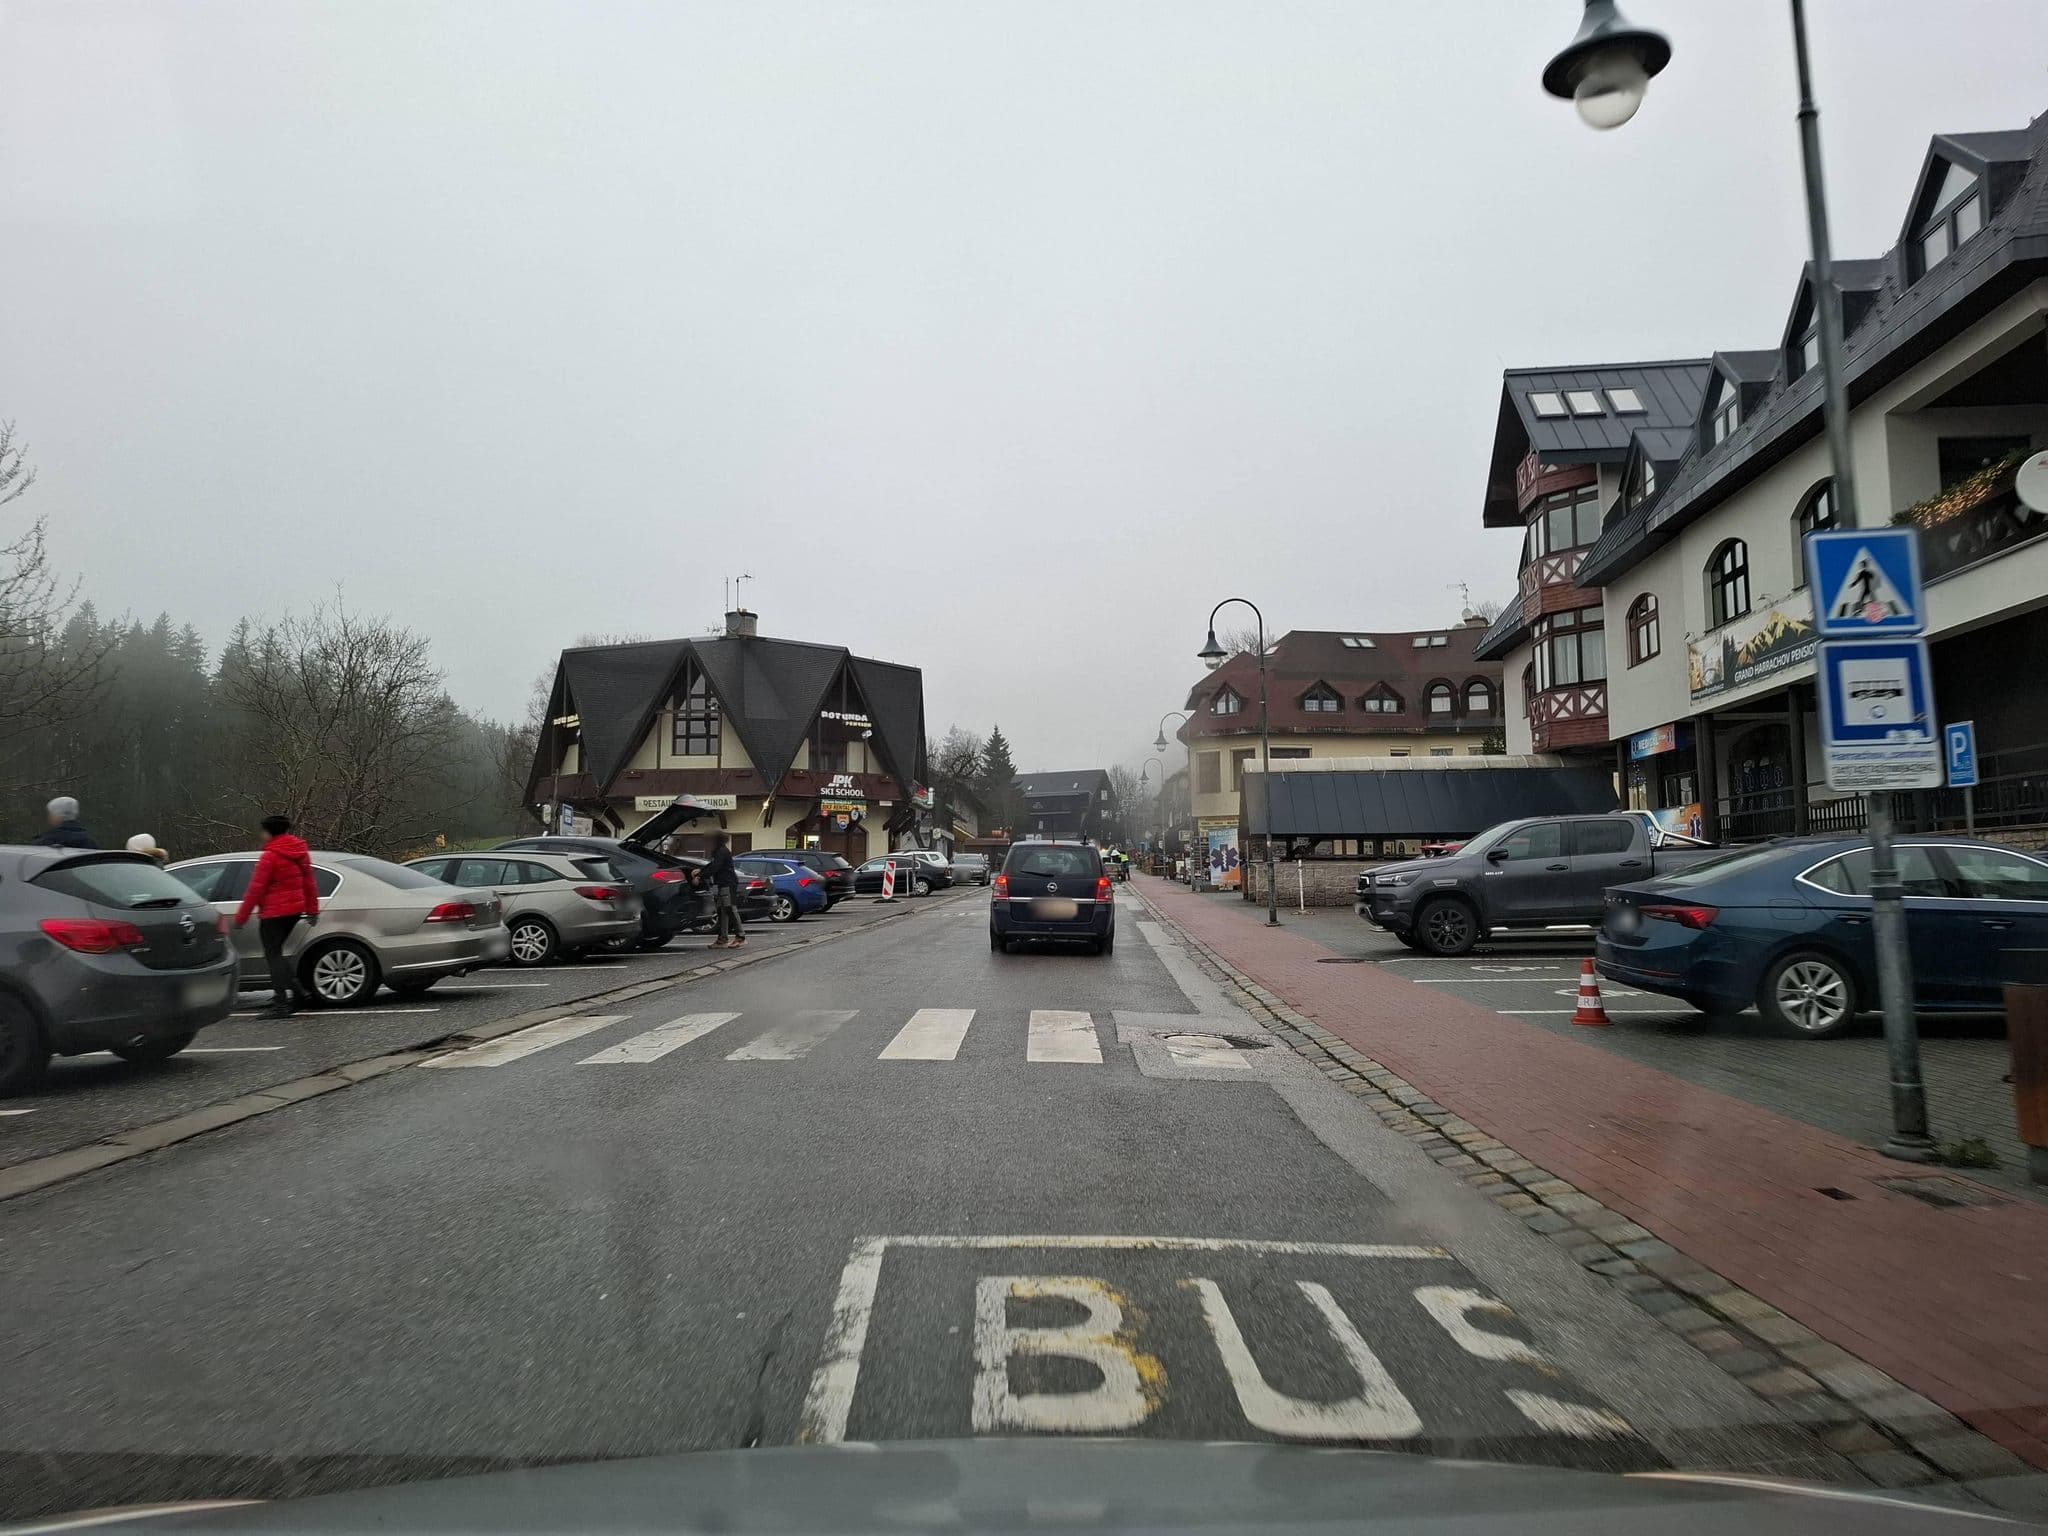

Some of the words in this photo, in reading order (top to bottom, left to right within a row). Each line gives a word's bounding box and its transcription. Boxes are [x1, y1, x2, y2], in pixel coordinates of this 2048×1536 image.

[1735, 669, 1754, 682] GRAND
[1754, 652, 1790, 674] HARRACHOV
[1951, 732, 1967, 767] P
[820, 787, 834, 796] SKI
[835, 789, 865, 797] SCHOOL
[828, 774, 853, 788] JPK
[972, 1274, 1634, 1439] BUS
